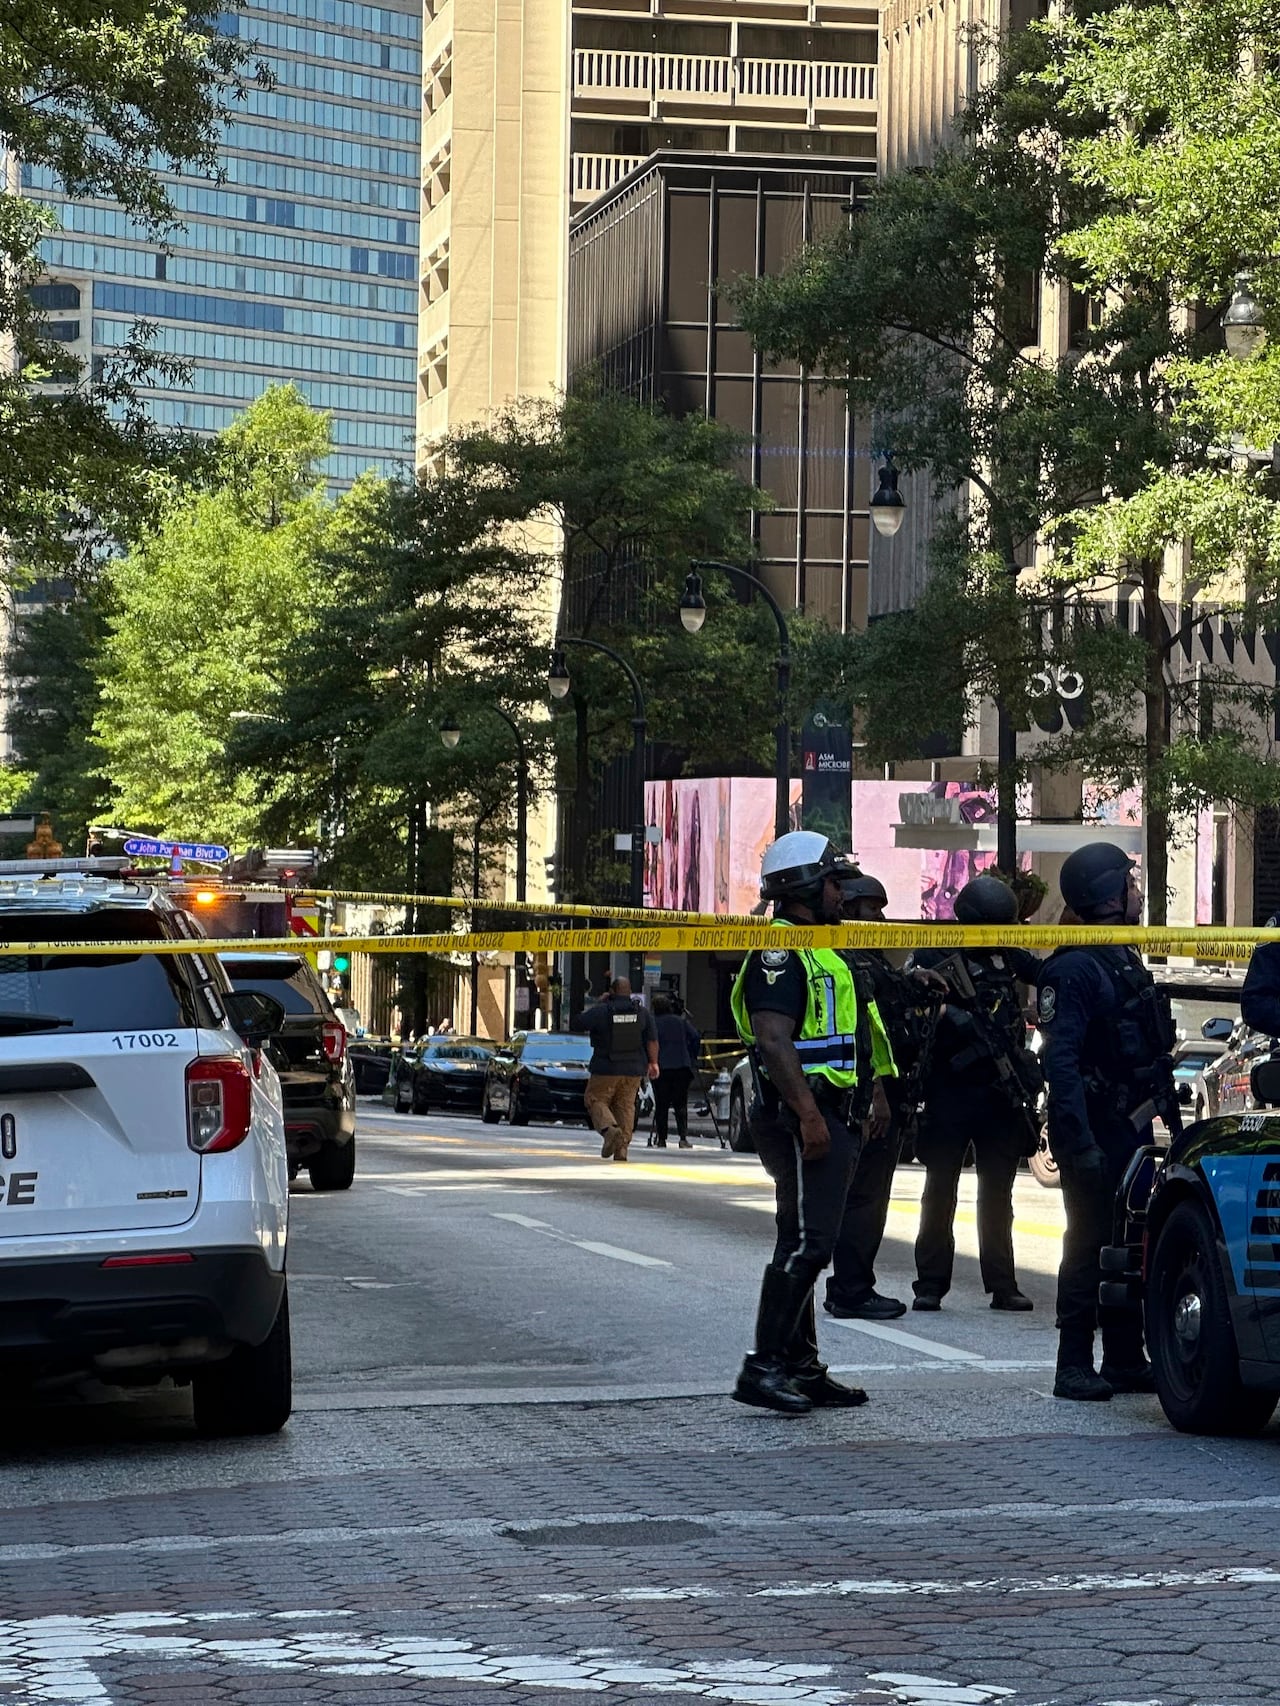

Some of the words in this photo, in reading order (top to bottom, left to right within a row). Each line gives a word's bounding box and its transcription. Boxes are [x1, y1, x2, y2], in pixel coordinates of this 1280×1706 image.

[818, 753, 835, 761] ASM
[818, 761, 850, 769] MICROBE
[140, 843, 157, 853] John
[195, 846, 214, 859] Blvd
[1196, 942, 1219, 957] CROSS
[112, 1033, 179, 1050] 17002
